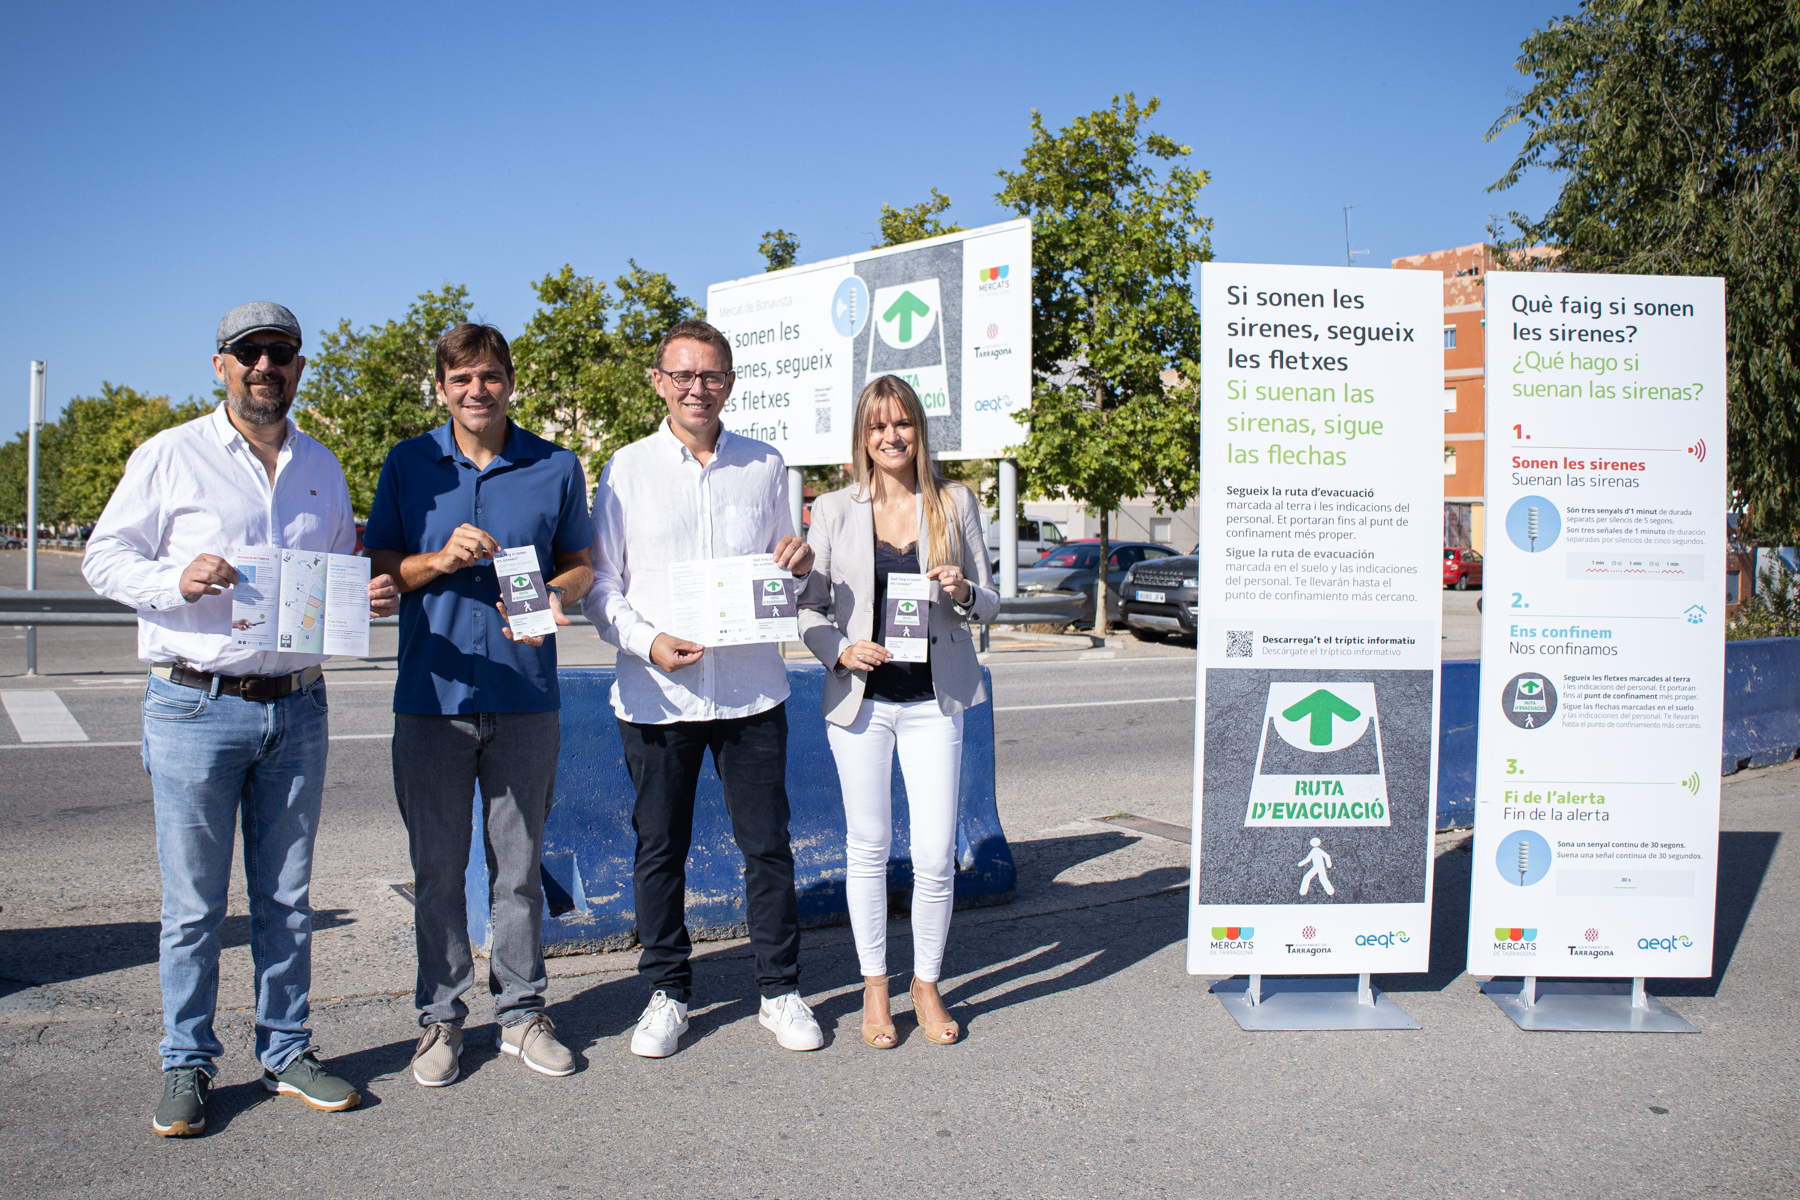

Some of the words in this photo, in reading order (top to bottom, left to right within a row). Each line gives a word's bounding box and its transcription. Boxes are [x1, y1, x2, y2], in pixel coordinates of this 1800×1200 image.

[979, 280, 1009, 292] MERCATS
[1227, 285, 1248, 305] Si
[1256, 292, 1324, 308] sonen
[1333, 288, 1365, 309] les
[745, 303, 754, 313] de
[1511, 294, 1553, 316] Què
[1559, 296, 1602, 319] faig
[1609, 297, 1626, 315] si
[1633, 302, 1694, 317] sonen
[735, 328, 775, 348] sonen
[780, 321, 800, 341] les
[1227, 317, 1319, 341] sirenes,
[1327, 322, 1414, 346] segueix
[1513, 322, 1542, 341] les
[1549, 324, 1638, 343] sirenes?
[776, 348, 833, 379] segueix
[1228, 348, 1261, 369] les
[1268, 349, 1349, 371] fletxes
[1512, 351, 1564, 374] ¿Qué
[1570, 352, 1618, 376] hago
[1623, 353, 1639, 372] si
[1227, 380, 1246, 400] Si
[1255, 386, 1335, 402] suenan
[1344, 383, 1374, 404] las
[1512, 384, 1582, 398] suenan
[1589, 380, 1616, 399] las
[1622, 382, 1704, 401] sirenas?
[724, 397, 737, 413] es
[742, 390, 790, 411] fletxes
[1227, 412, 1316, 436] sirenas,
[1324, 414, 1384, 440] sigue
[1513, 424, 1531, 440] 1.
[1228, 443, 1259, 464] las
[1267, 444, 1346, 466] flechas
[1512, 456, 1558, 469] Sonen
[1563, 457, 1585, 470] les
[1590, 458, 1646, 471] sirenes
[1512, 472, 1562, 486] Suenan
[1566, 473, 1586, 487] las
[1589, 474, 1640, 488] sirenas
[1226, 486, 1269, 498] Segueix
[1272, 486, 1282, 496] la
[1284, 488, 1308, 496] ruta
[1310, 488, 1374, 498] d'evacuació
[1226, 501, 1272, 510] marcada
[1274, 501, 1284, 510] al
[1286, 502, 1312, 511] terra
[1314, 501, 1317, 511] i
[1319, 501, 1334, 512] les
[1336, 502, 1393, 512] indicacions
[1394, 503, 1410, 513] del
[1596, 508, 1624, 516] senyals
[1226, 515, 1274, 526] personal.
[1277, 515, 1287, 525] Et
[1290, 516, 1335, 527] portaran
[1337, 516, 1356, 526] fins
[1358, 516, 1367, 526] al
[1370, 518, 1394, 528] punt
[1395, 517, 1409, 527] de
[1226, 528, 1292, 538] confinament
[1294, 529, 1316, 539] més
[1318, 531, 1356, 542] proper.
[1226, 548, 1256, 560] Sigue
[1258, 548, 1268, 558] la
[1271, 549, 1295, 558] ruta
[1297, 548, 1311, 558] de
[1313, 550, 1375, 559] evacuación
[1225, 563, 1271, 572] marcada
[1273, 564, 1287, 572] en
[1289, 563, 1299, 572] el
[1301, 563, 1329, 573] suelo
[1330, 565, 1338, 575] y
[1339, 563, 1354, 573] las
[1356, 564, 1418, 574] indicaciones
[1225, 576, 1241, 586] del
[1244, 577, 1292, 588] personal.
[1294, 576, 1307, 587] Te
[1309, 577, 1350, 587] llevarán
[1352, 577, 1380, 588] hasta
[1382, 578, 1392, 588] el
[1225, 591, 1257, 602] punto
[1258, 590, 1272, 600] de
[1274, 591, 1349, 601] confinamiento
[1351, 592, 1373, 602] más
[1375, 594, 1418, 602] cercano.
[1511, 592, 1530, 608] 2.
[1510, 624, 1537, 638] Ens
[1541, 626, 1612, 639] confinem
[1262, 636, 1321, 646] Descarrega't
[1323, 636, 1332, 644] el
[1335, 636, 1365, 646] tríptic
[1367, 636, 1416, 645] informatiu
[1509, 641, 1536, 655] Nos
[1539, 642, 1618, 656] confinamos
[1262, 646, 1309, 657] Descárgate
[1309, 647, 1318, 656] el
[1320, 647, 1353, 657] tríptico
[1353, 647, 1402, 656] informativo
[1563, 674, 1591, 682] Segueix
[1506, 758, 1524, 774] 3.
[1295, 780, 1344, 796] RUTA
[1504, 790, 1518, 803] Fi
[1523, 791, 1542, 804] de
[1546, 791, 1605, 804] l'alerta
[1251, 798, 1384, 820] D'EVACUACIÓ
[1504, 807, 1526, 820] Fin
[1529, 808, 1547, 821] de
[1551, 808, 1563, 821] la
[1566, 808, 1610, 822] alerta
[1587, 841, 1611, 849] senyal
[1210, 941, 1254, 950] MERCATS
[1355, 931, 1395, 948] aeqt
[1494, 942, 1537, 951] MERCATS
[1638, 935, 1678, 952] aeqt
